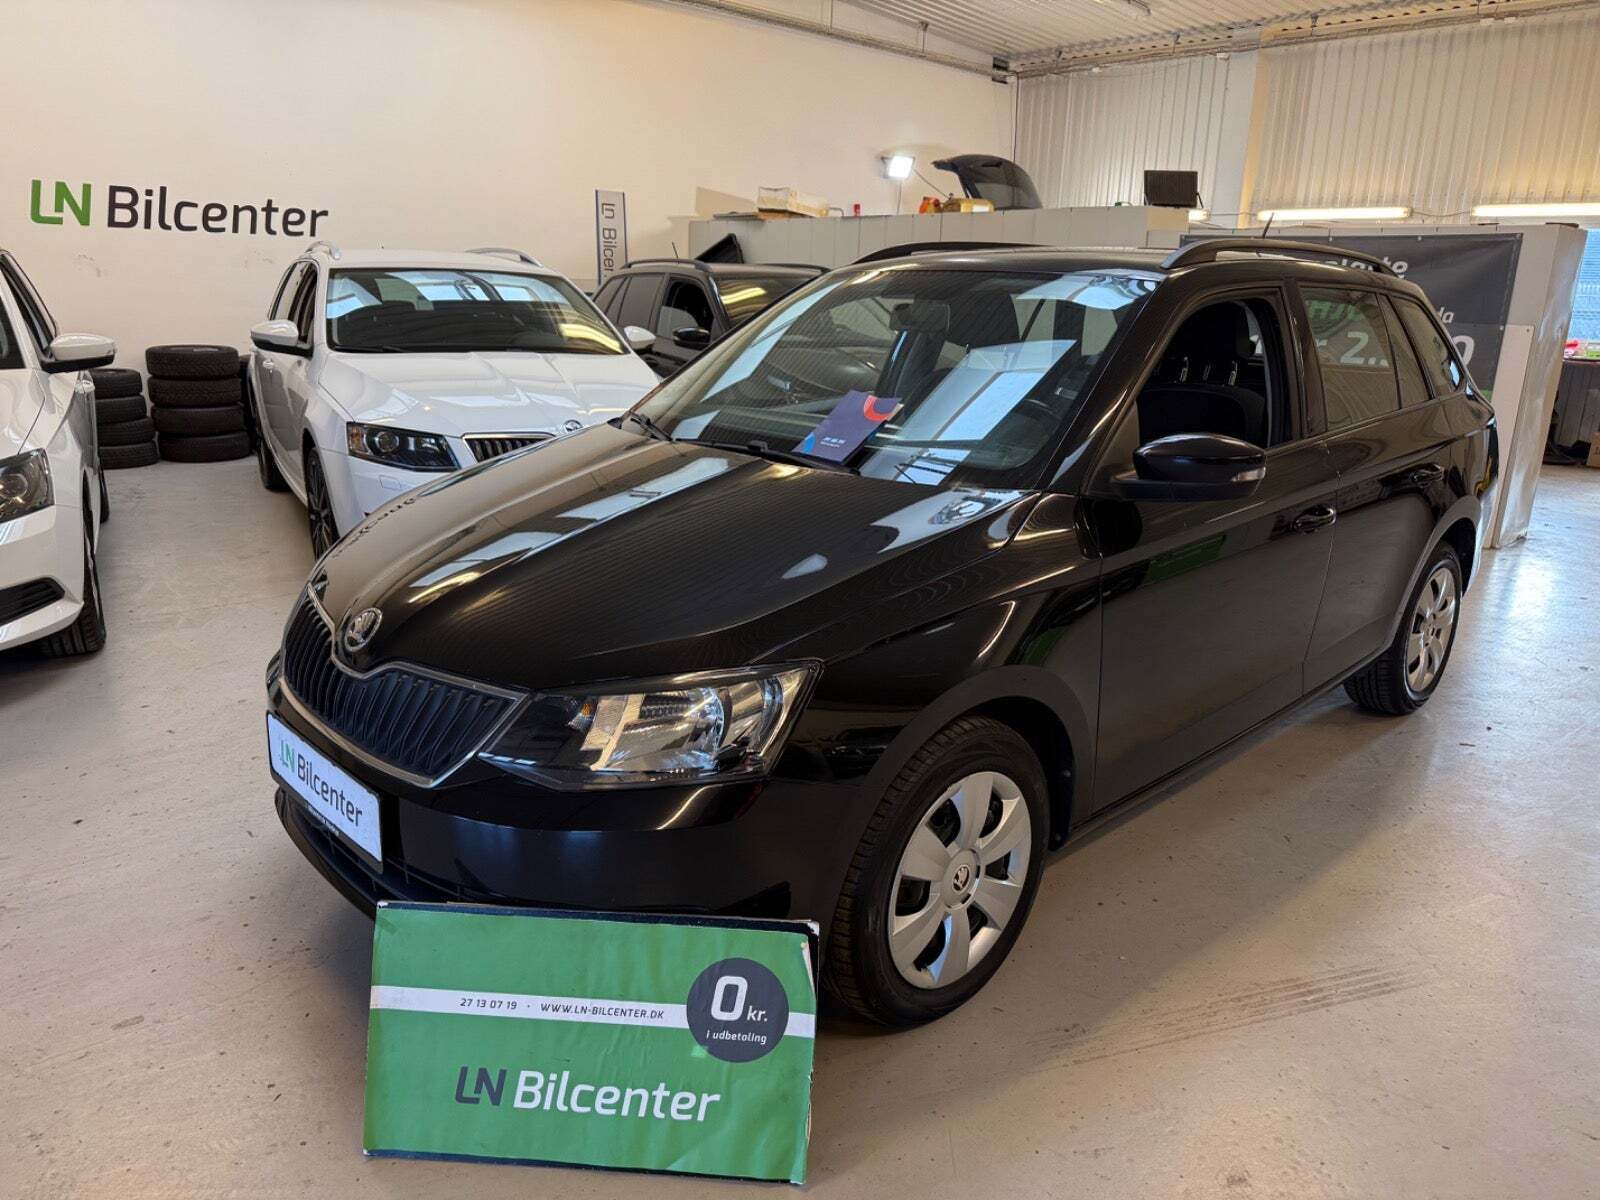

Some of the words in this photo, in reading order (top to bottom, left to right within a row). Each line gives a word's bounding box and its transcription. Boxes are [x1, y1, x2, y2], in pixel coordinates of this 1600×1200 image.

[30, 179, 92, 226] LN
[107, 185, 329, 237] Bilcenter
[280, 739, 295, 773] LN
[297, 753, 363, 827] Bilcenter
[460, 998, 473, 1007] 27
[476, 998, 486, 1008] 13
[489, 1000, 503, 1009] 07
[506, 1001, 518, 1010] 19
[540, 1003, 664, 1020] WWW.LN-BILCENTER.DK
[711, 975, 748, 1021] 0
[746, 1005, 768, 1022] kr.
[712, 1030, 767, 1045] udbetaling
[454, 1066, 507, 1106] LN
[513, 1070, 721, 1121] Bilcenter
